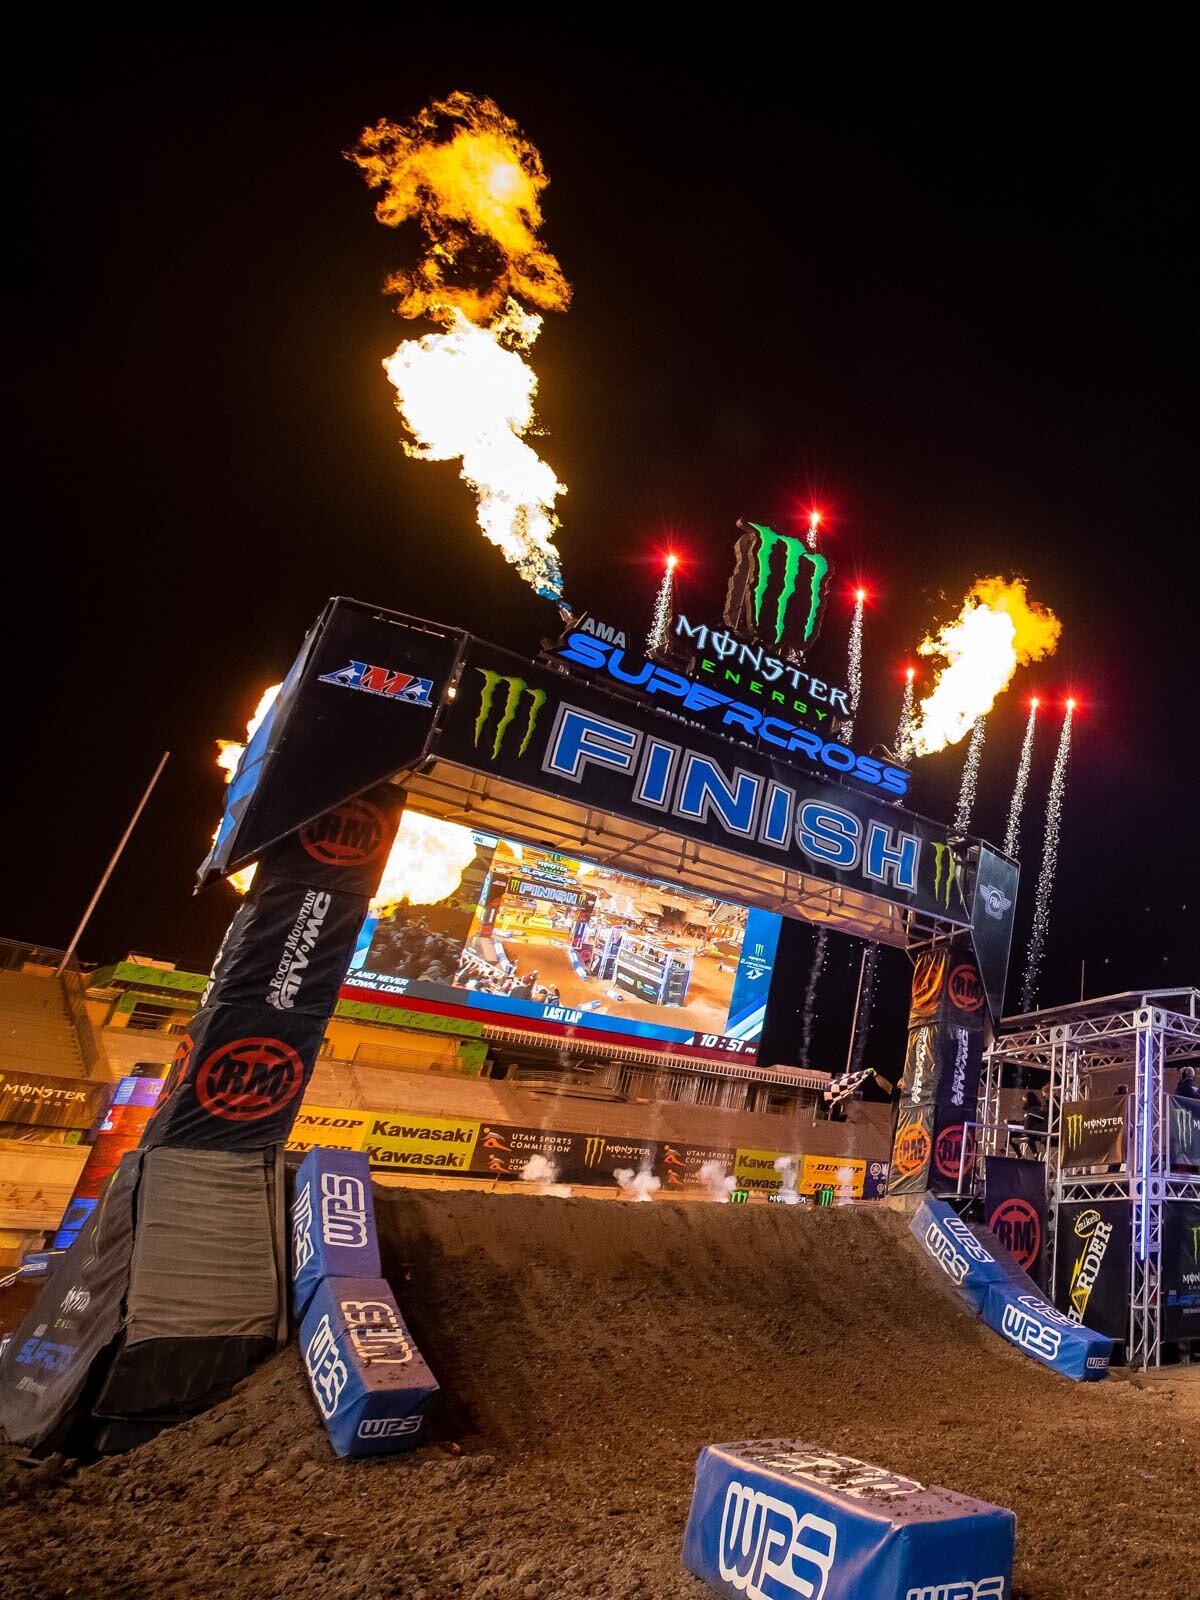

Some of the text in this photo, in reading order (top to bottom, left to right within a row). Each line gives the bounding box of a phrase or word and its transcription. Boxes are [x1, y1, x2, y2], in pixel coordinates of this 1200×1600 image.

[581, 617, 626, 649] AMA
[675, 614, 850, 715] MONSTER
[318, 660, 433, 705] AMA
[702, 659, 828, 721] ENERGY
[559, 633, 912, 796] SUPERCROSS
[542, 701, 922, 895] FINISH
[519, 882, 578, 904] FINISH
[269, 889, 318, 991] ROCKY MOUNTAIN
[376, 974, 409, 985] NEVER
[378, 984, 407, 995] LOOK
[543, 1006, 582, 1023] LAST LAP
[745, 1046, 756, 1054] PM
[217, 1061, 285, 1098] RM
[3, 1084, 86, 1102] MONSTER
[13, 1096, 72, 1107] ENERGY
[372, 1120, 474, 1144] Kawasaki
[1083, 1116, 1124, 1130] MONSTER
[510, 1141, 570, 1153] COMMISSION
[512, 1133, 572, 1145] UTAH SPORTS
[605, 1145, 651, 1156] MONSTER
[366, 1144, 468, 1168] Kawasaki
[686, 1150, 734, 1160] UTAH SPORTS
[943, 1217, 996, 1263] WPS
[1000, 1220, 1036, 1252] RM
[925, 1222, 970, 1285] WPS
[1002, 1303, 1062, 1361] WPS
[1087, 1358, 1109, 1369] WPS
[357, 1415, 424, 1440] WPS
[718, 1481, 838, 1600] WPS
